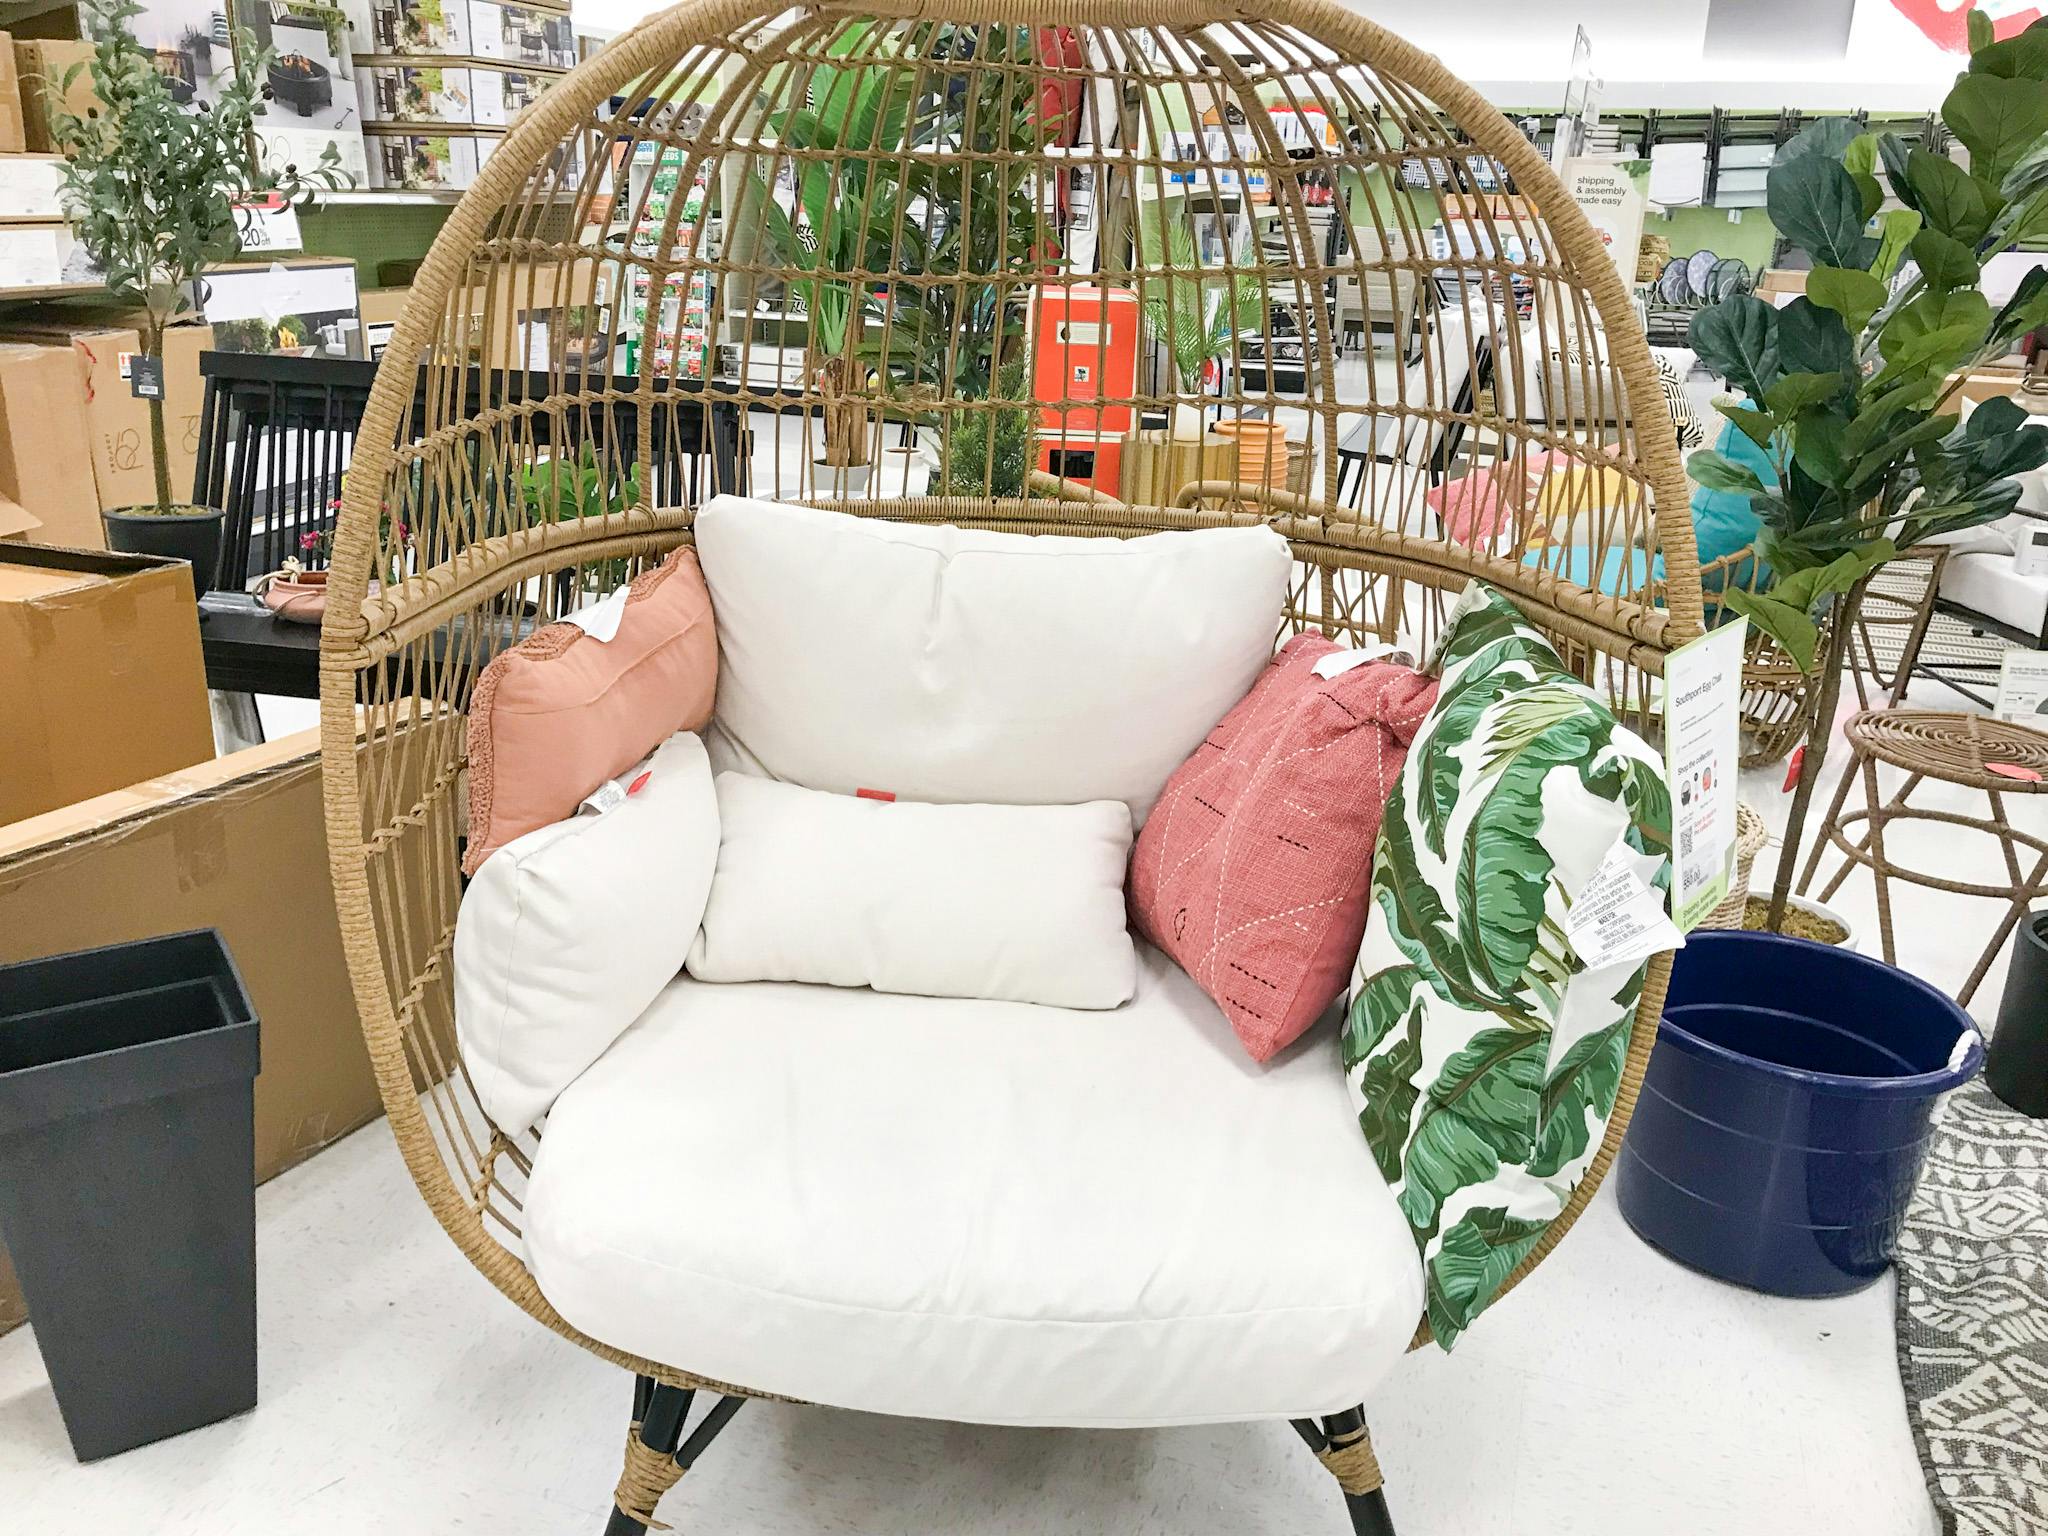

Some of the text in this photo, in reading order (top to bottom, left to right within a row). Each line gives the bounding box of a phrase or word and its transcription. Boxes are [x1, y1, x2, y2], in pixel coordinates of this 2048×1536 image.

[662, 151, 680, 160] EEDS
[1577, 176, 1615, 186] shipping
[1576, 185, 1627, 196] & assembly
[1575, 196, 1623, 206] made easy
[242, 228, 260, 247] 20
[1675, 686, 1702, 708] Southport
[1702, 681, 1712, 694] Egg
